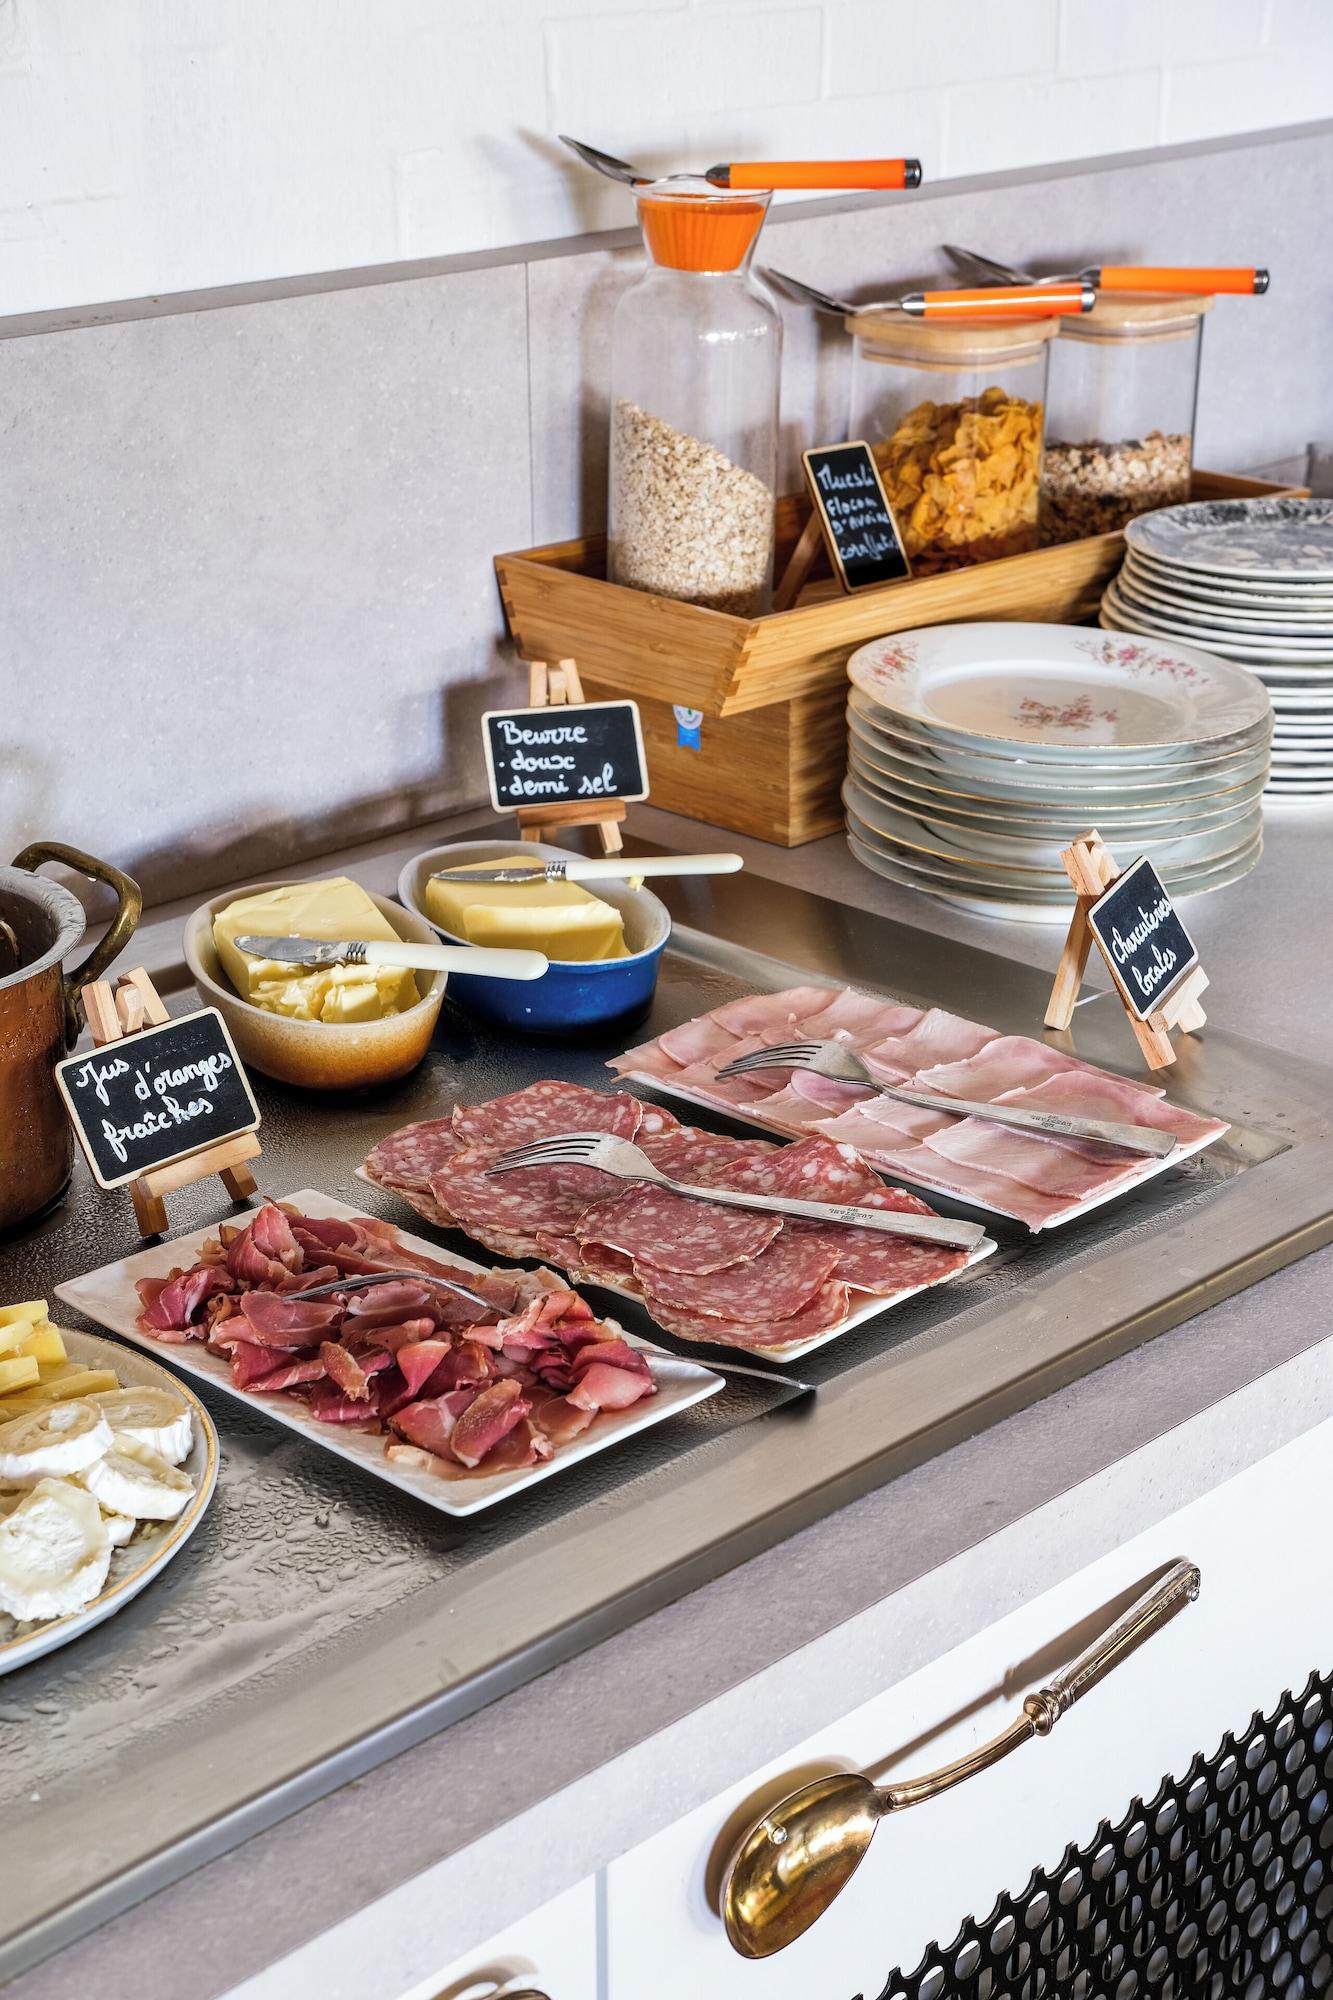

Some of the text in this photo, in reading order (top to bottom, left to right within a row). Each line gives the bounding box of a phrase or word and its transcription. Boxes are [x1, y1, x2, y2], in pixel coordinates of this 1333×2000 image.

[497, 720, 588, 745] Beurre
[510, 749, 576, 772] doux
[509, 762, 618, 796] demi sel
[76, 1052, 233, 1106] Jus d'oranges
[101, 1095, 214, 1163] fraîches
